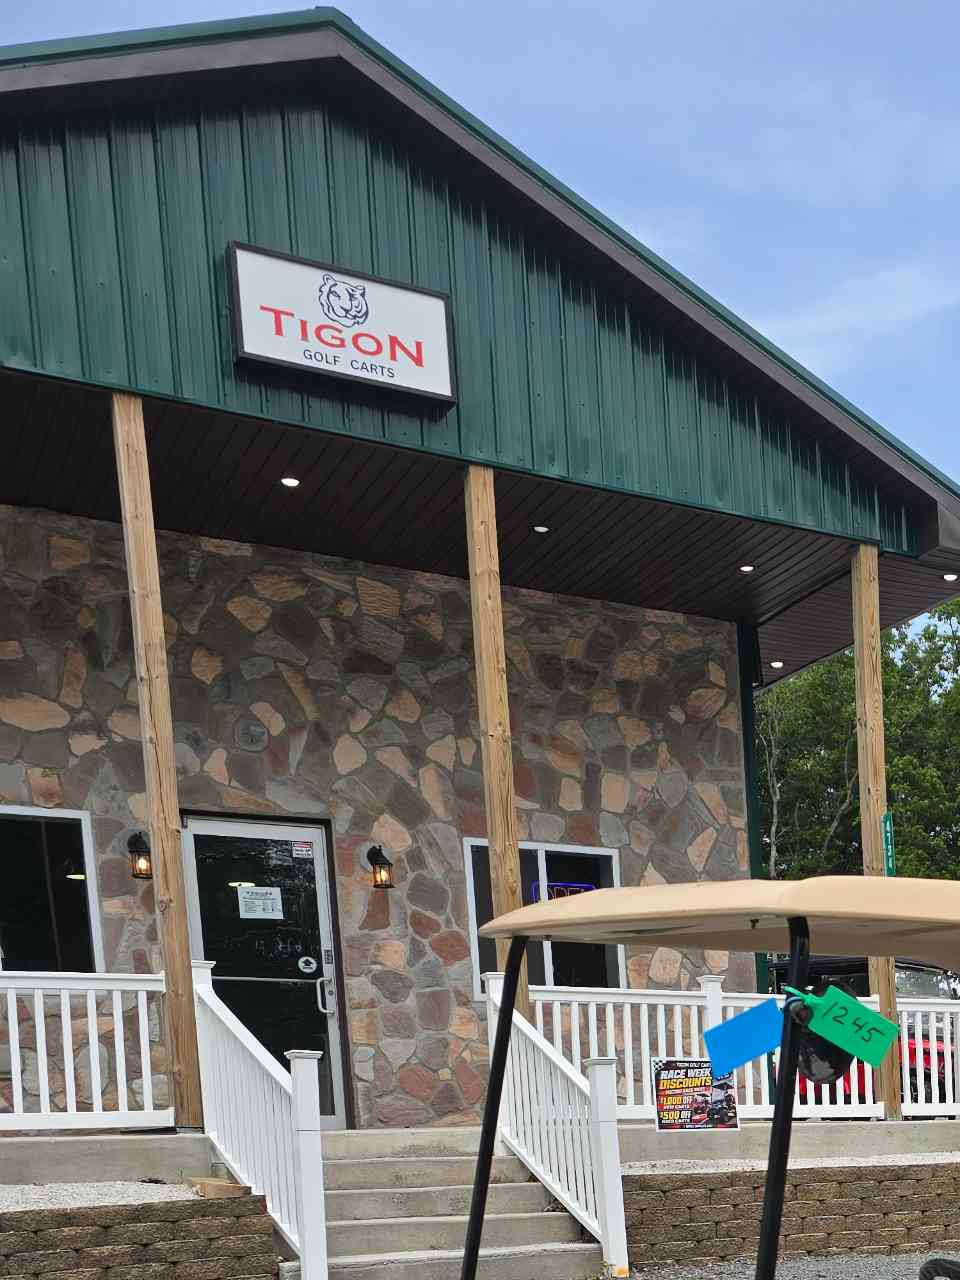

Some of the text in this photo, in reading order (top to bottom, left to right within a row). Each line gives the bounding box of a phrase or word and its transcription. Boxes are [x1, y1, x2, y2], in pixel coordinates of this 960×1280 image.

[260, 304, 425, 368] TIGON
[303, 349, 396, 378] GOLF CARTS
[822, 1001, 885, 1042] 1245
[660, 1067, 712, 1079] RACE WEEK
[660, 1077, 712, 1088] DISCOUNTS
[682, 1096, 693, 1104] OFF
[681, 1110, 692, 1119] OFF
